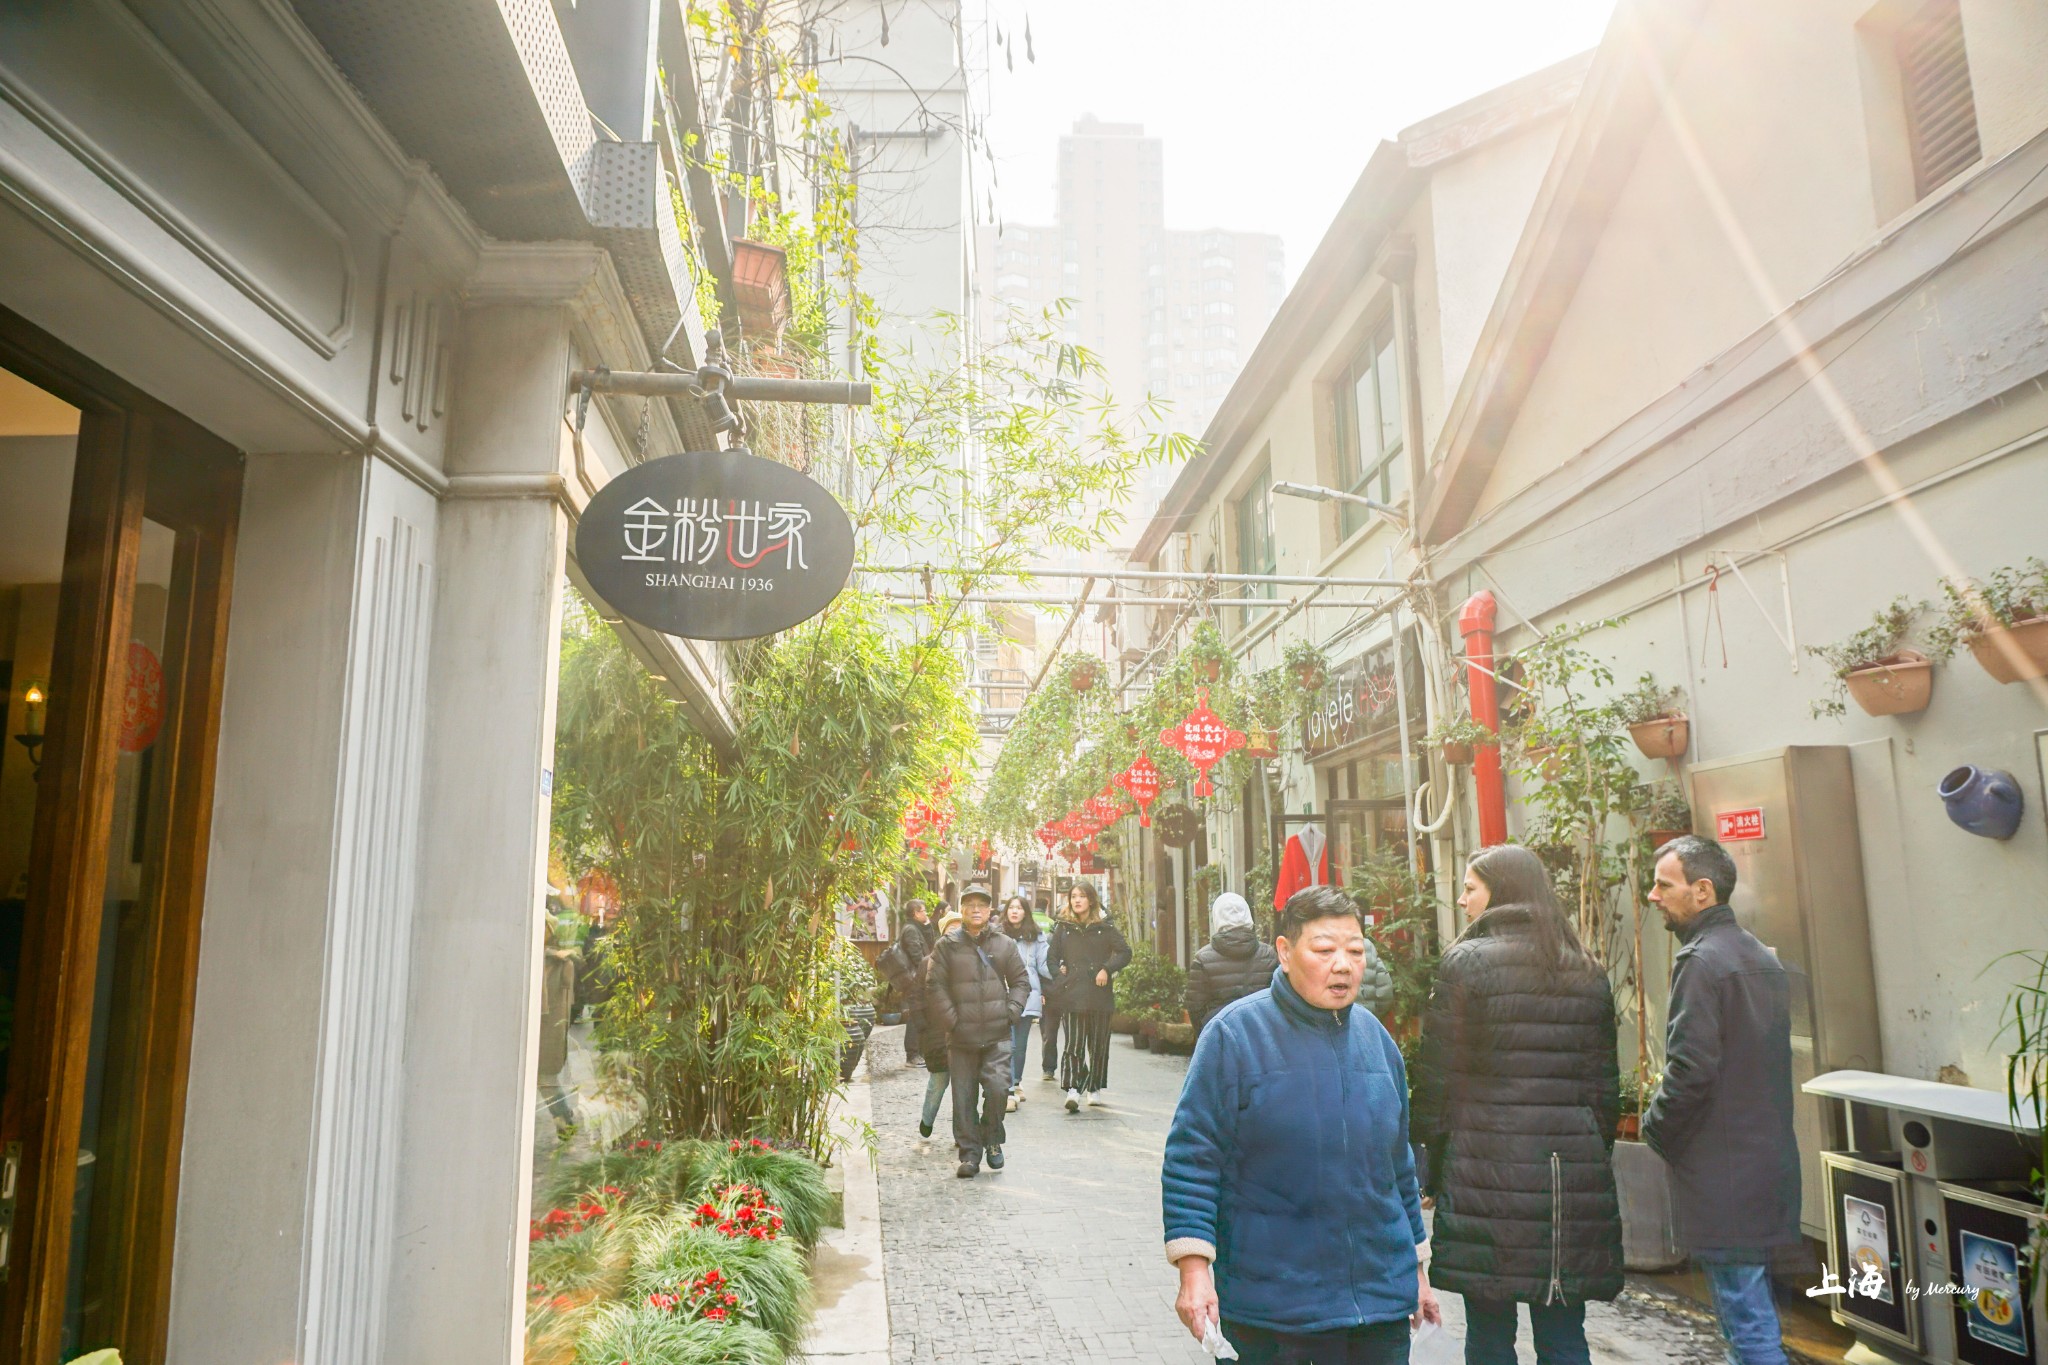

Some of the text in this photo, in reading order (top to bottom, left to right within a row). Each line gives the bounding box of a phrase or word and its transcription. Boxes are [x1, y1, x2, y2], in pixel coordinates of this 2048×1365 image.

[621, 496, 812, 570] 金粉世家
[644, 573, 774, 592] SHANGHAI 1936
[1736, 814, 1759, 827] 消火栓
